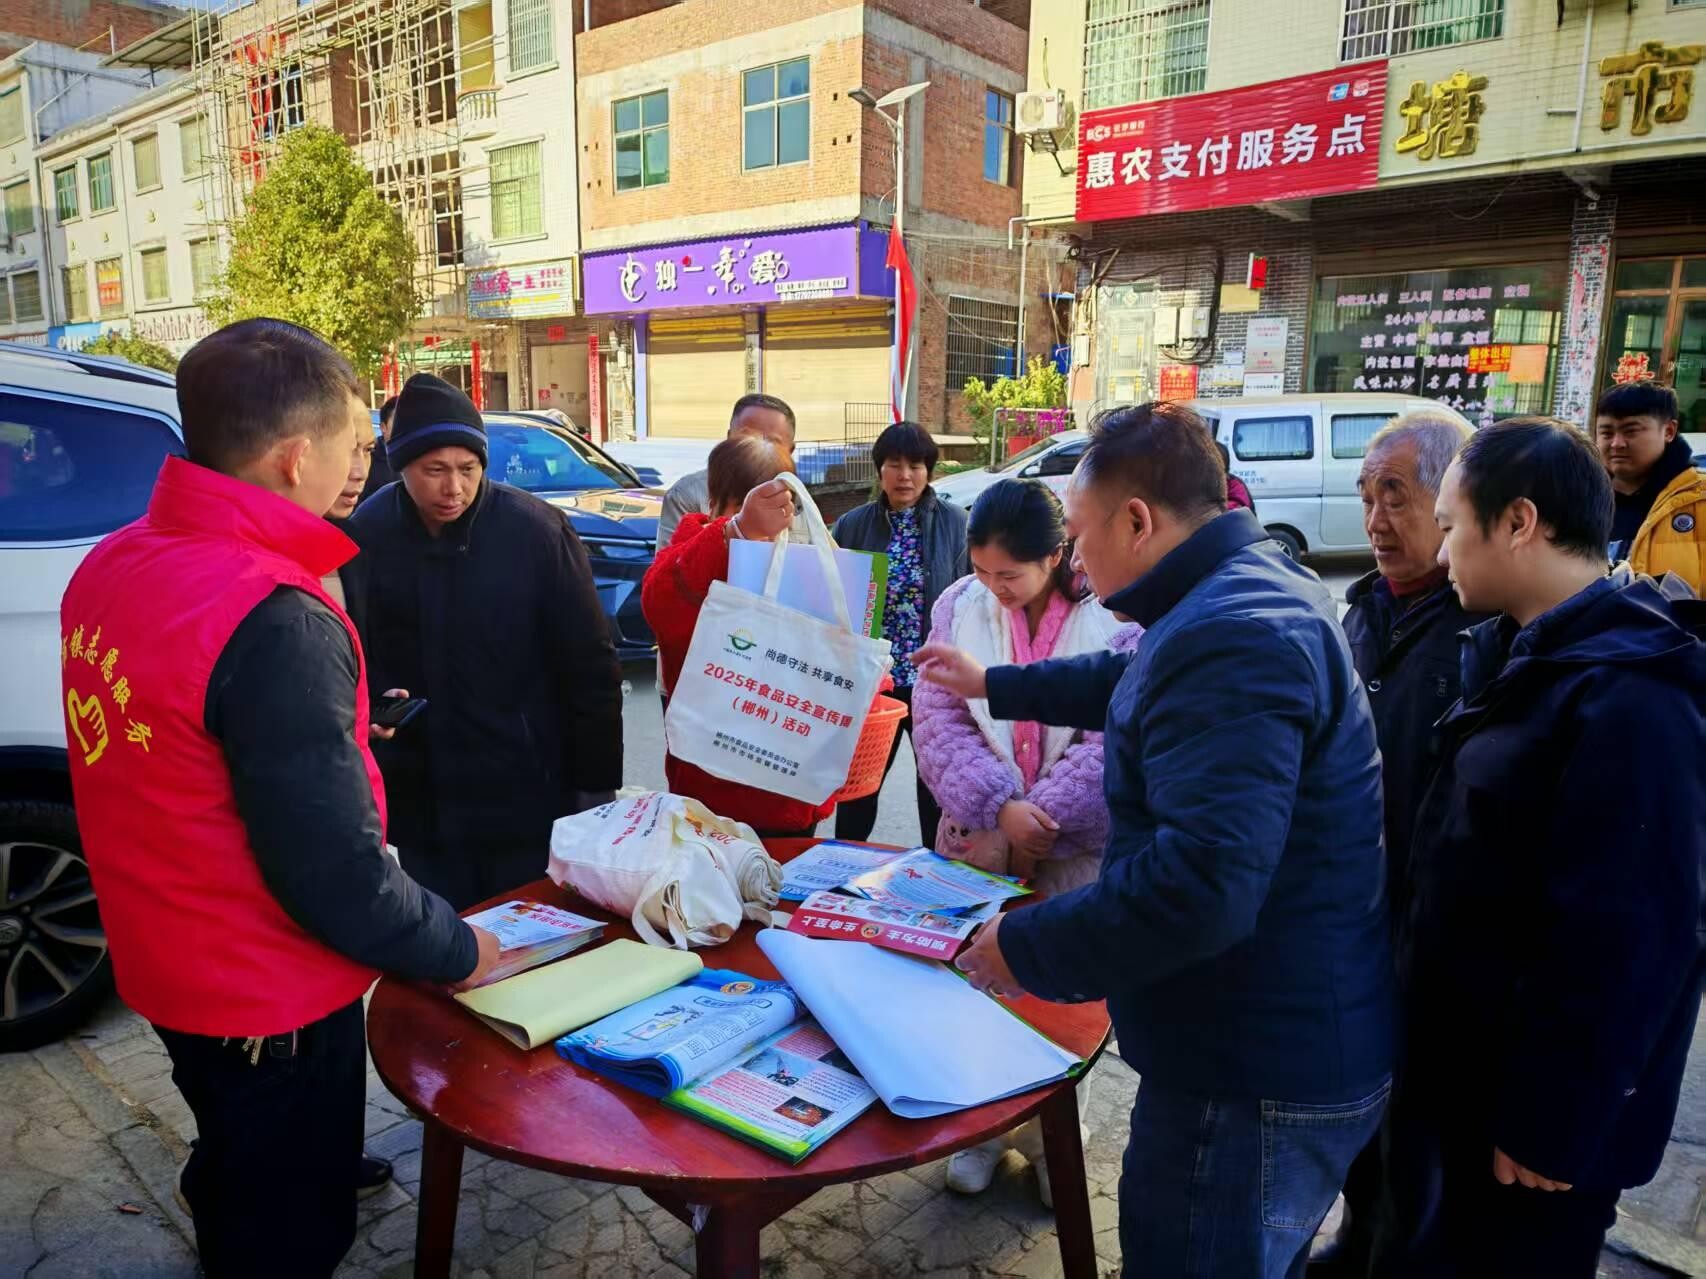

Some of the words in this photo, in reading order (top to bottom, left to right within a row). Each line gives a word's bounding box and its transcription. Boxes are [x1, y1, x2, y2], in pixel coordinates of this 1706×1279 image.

[1395, 68, 1490, 161] 塘
[1599, 39, 1704, 136] 市
[1085, 113, 1367, 190] 惠农支付服务点
[703, 662, 854, 730] 2025年食品安全宣传周
[765, 648, 810, 675] 尚德守法
[811, 665, 855, 693] 共享食安
[801, 914, 859, 933] 生命至上
[886, 928, 950, 952] 预防为主
